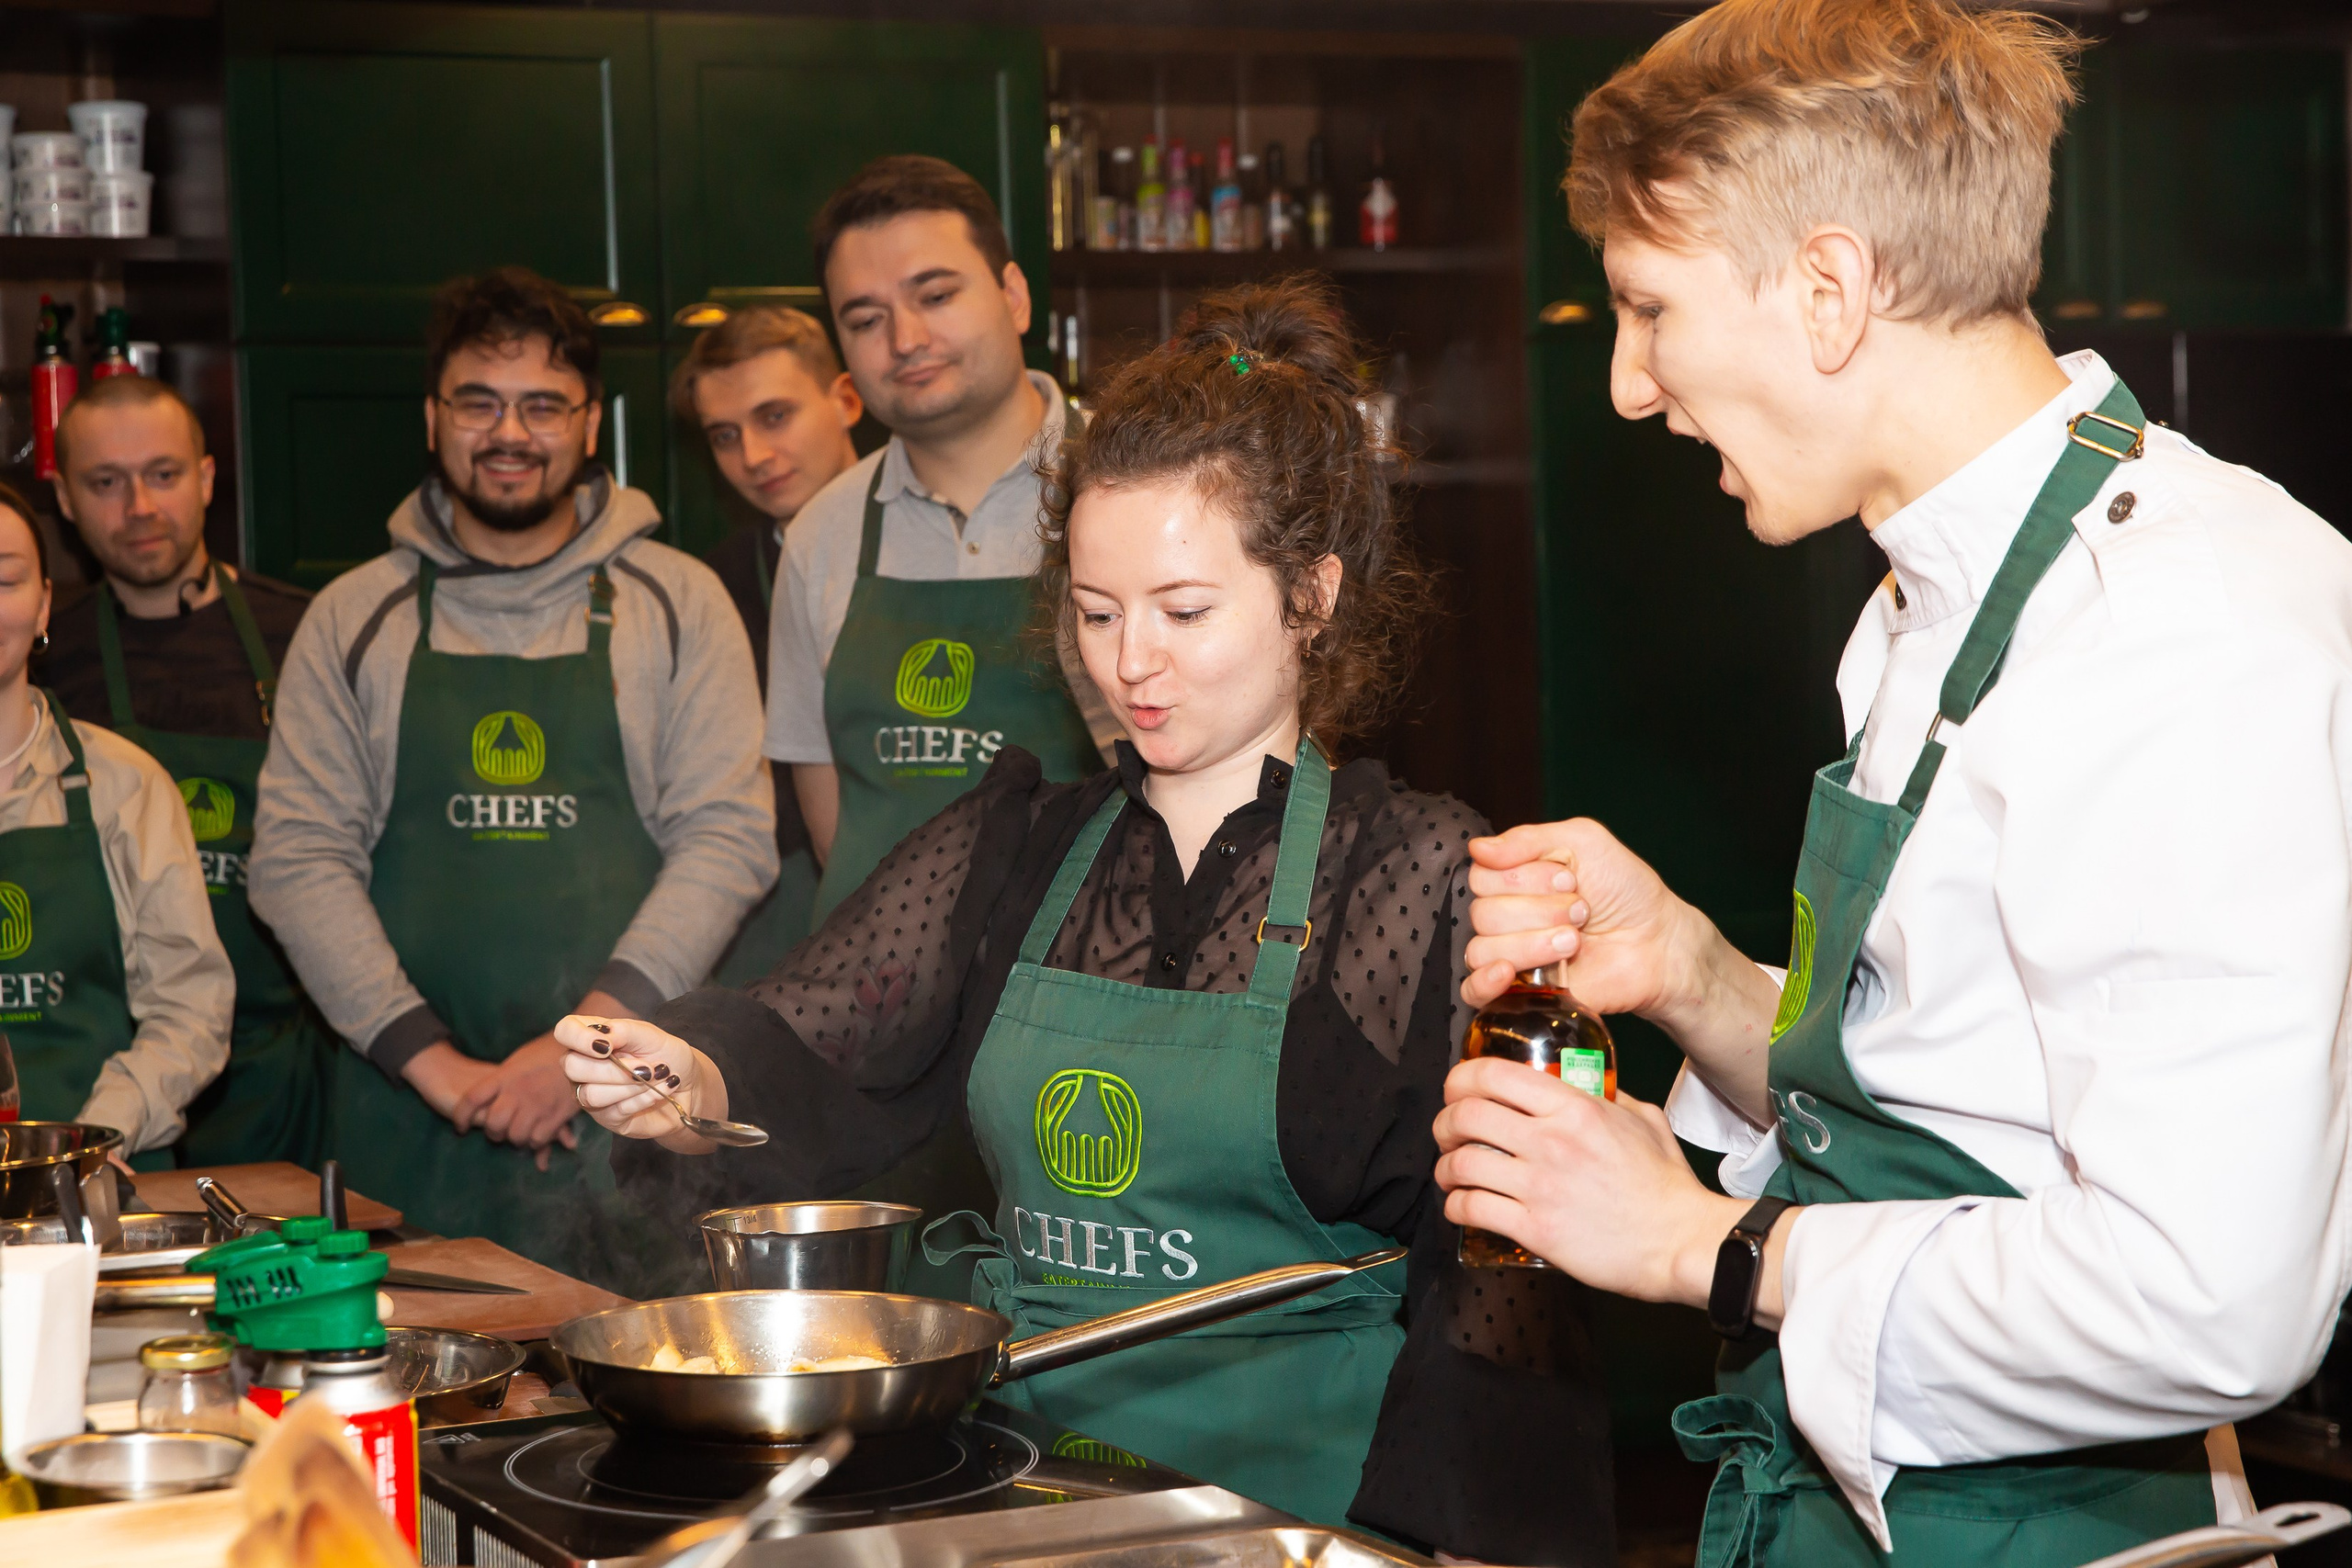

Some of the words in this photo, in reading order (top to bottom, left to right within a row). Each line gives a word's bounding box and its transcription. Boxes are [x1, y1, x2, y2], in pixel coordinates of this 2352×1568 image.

[876, 726, 1004, 764] CHEFS
[447, 793, 579, 829] CHEFS
[1014, 1206, 1198, 1281] CHEFS
